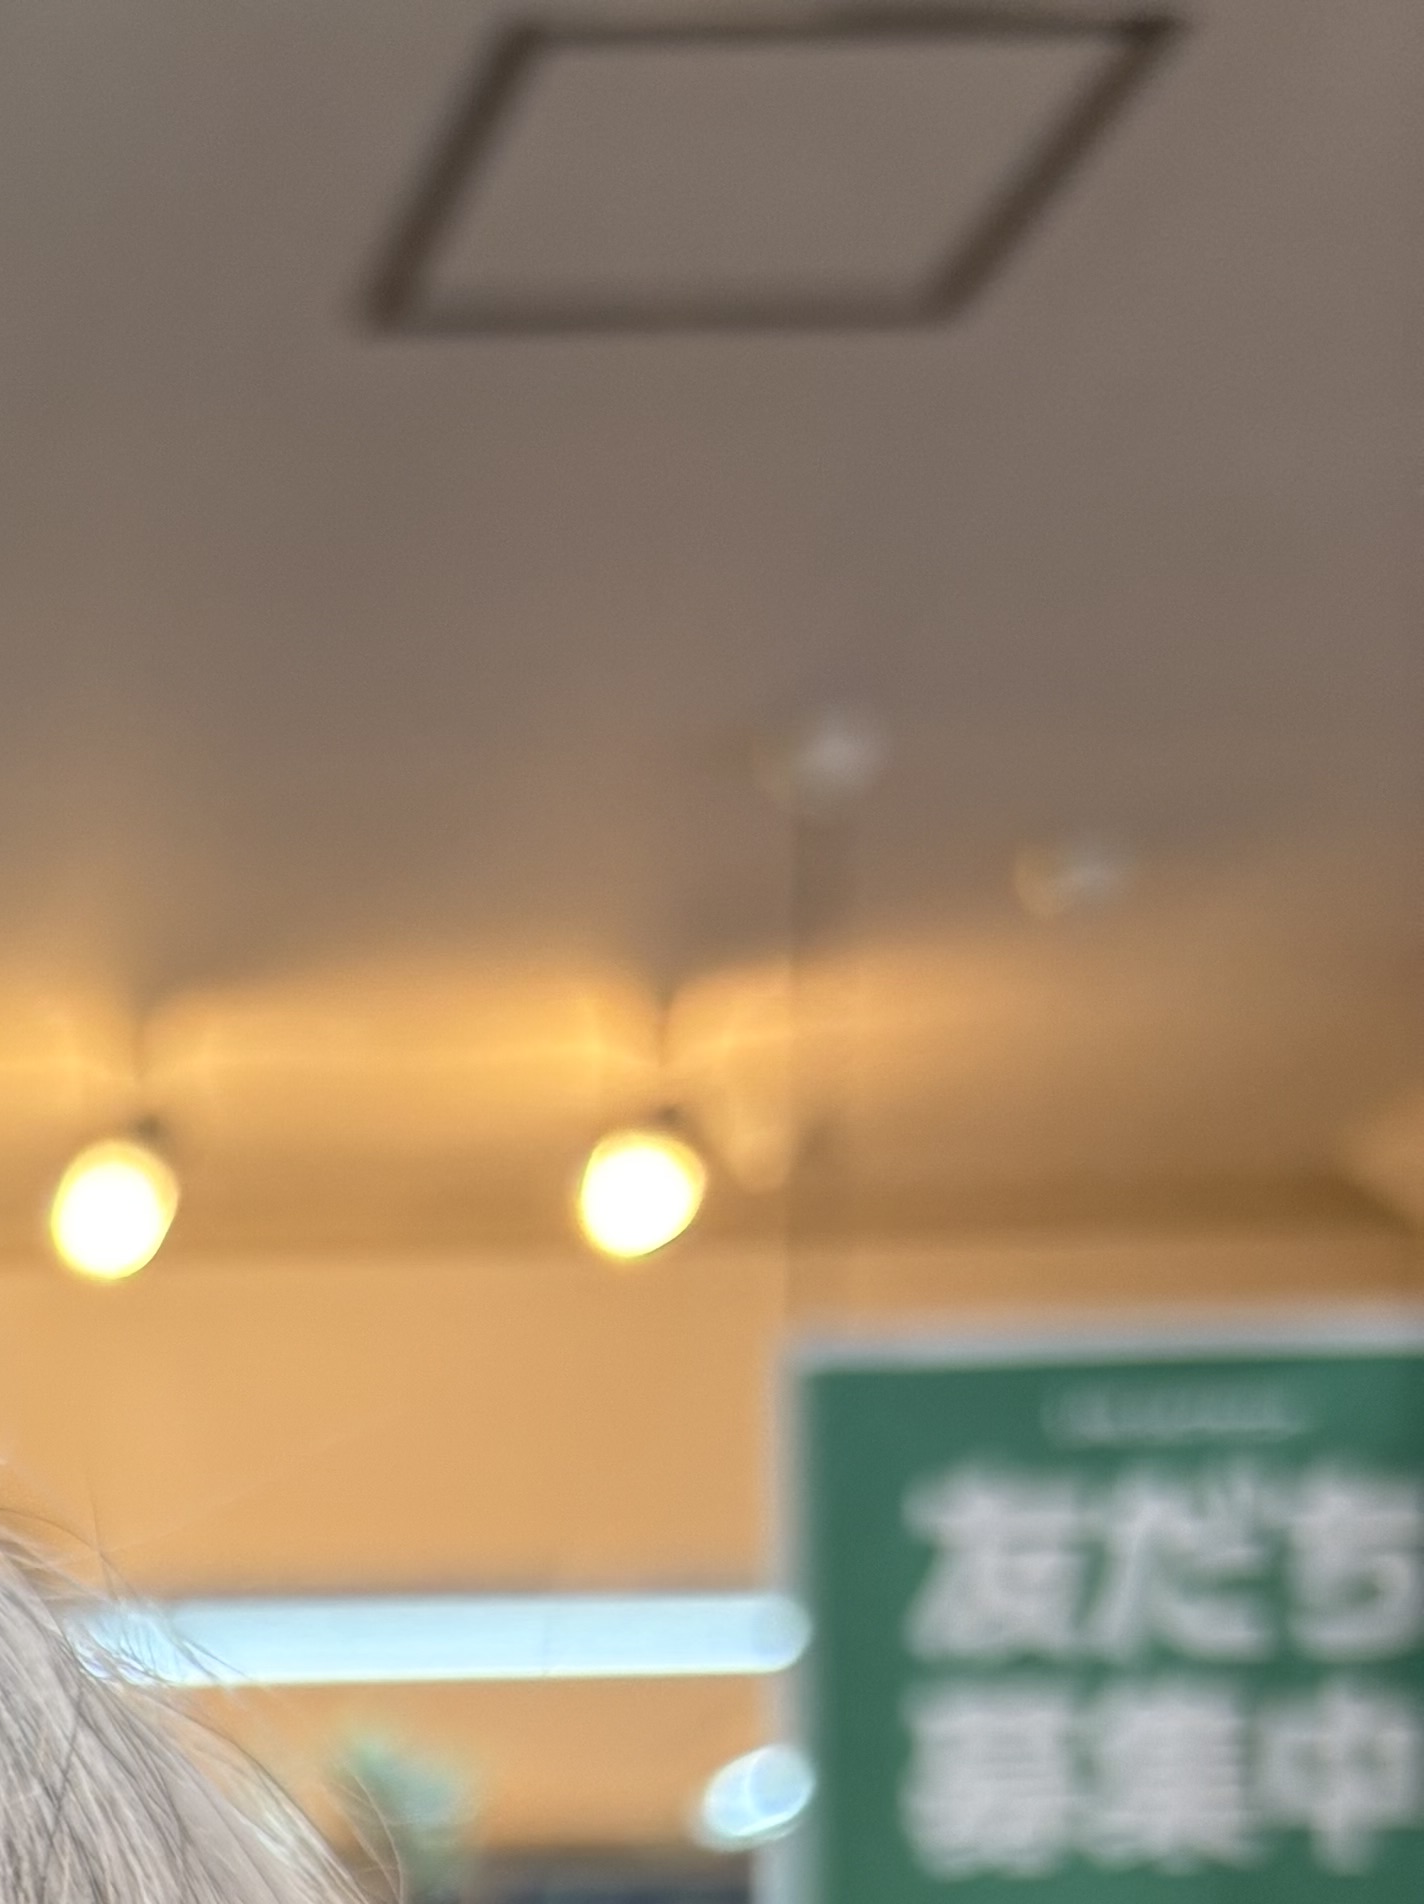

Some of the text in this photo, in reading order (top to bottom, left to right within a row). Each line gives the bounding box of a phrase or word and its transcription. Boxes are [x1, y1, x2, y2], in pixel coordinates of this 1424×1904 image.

[904, 1466, 1424, 1660] 友だち
[902, 1683, 1422, 1874] 募集中
